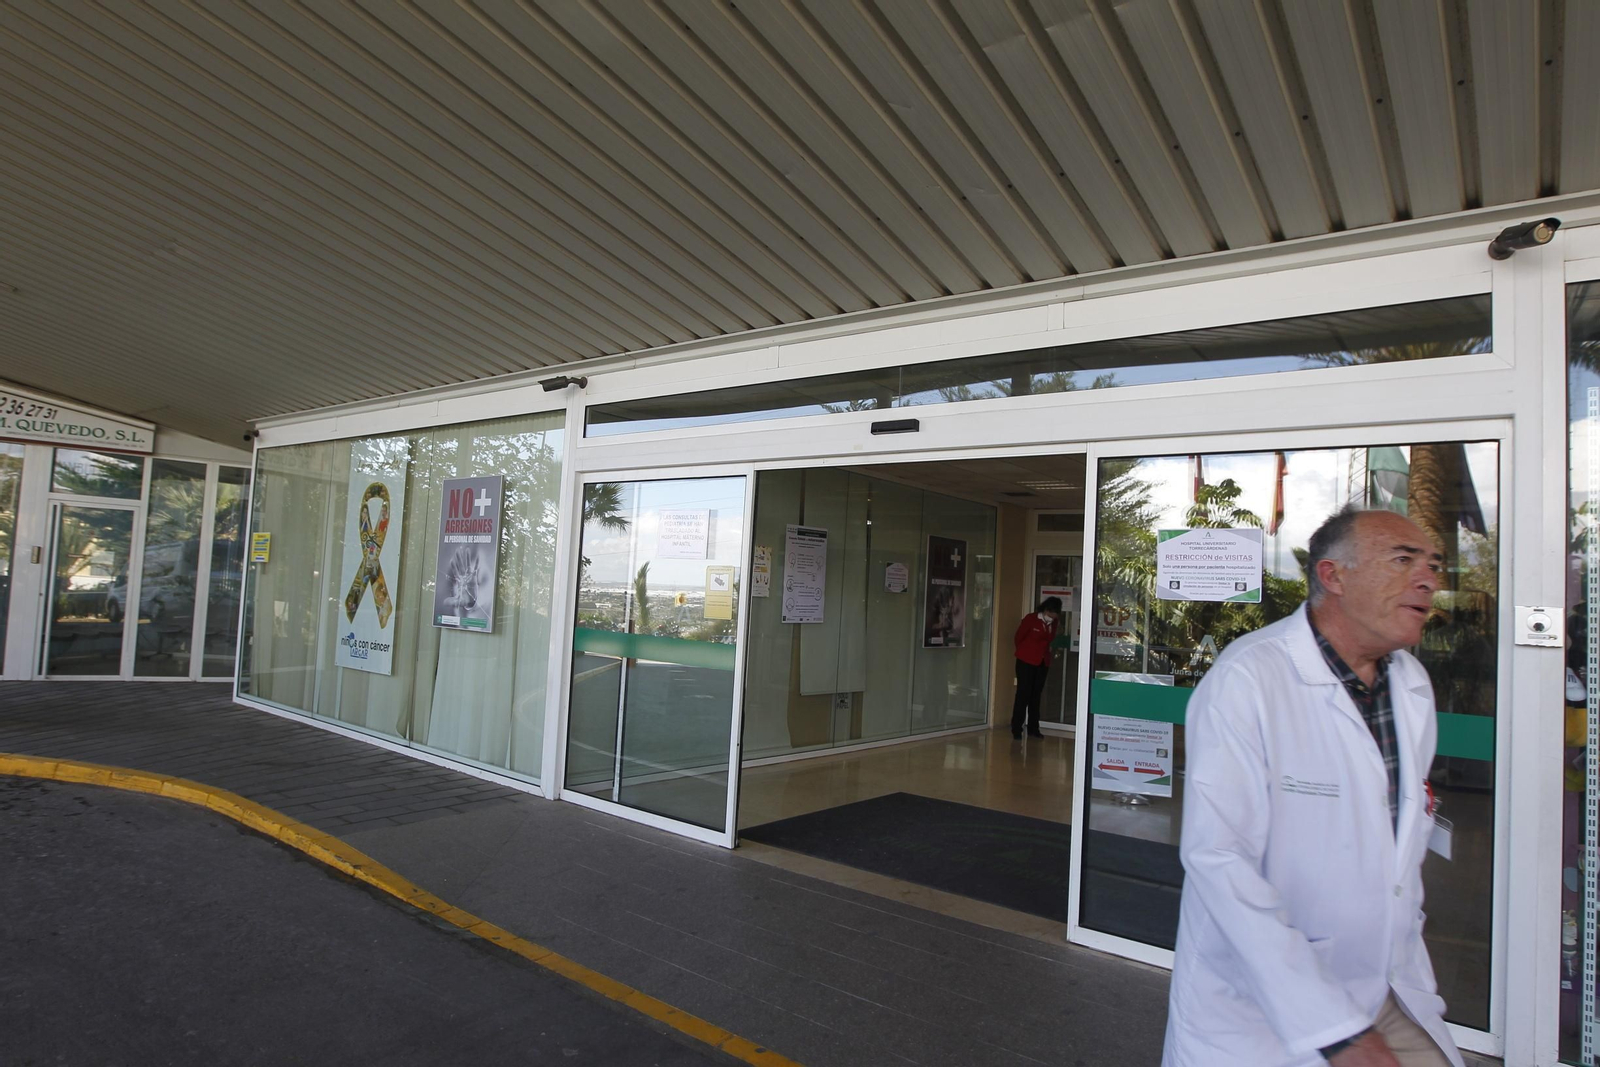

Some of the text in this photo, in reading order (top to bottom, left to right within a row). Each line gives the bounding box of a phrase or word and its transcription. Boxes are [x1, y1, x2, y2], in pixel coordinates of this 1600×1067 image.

[15, 419, 111, 440] QUEVEDO,
[115, 429, 146, 443] S.L.
[444, 518, 493, 534] AGRESIONES
[1165, 553, 1213, 561] RESTRICCIÓN
[358, 639, 369, 650] con
[369, 640, 391, 652] cáncer
[1170, 667, 1193, 676] Junta
